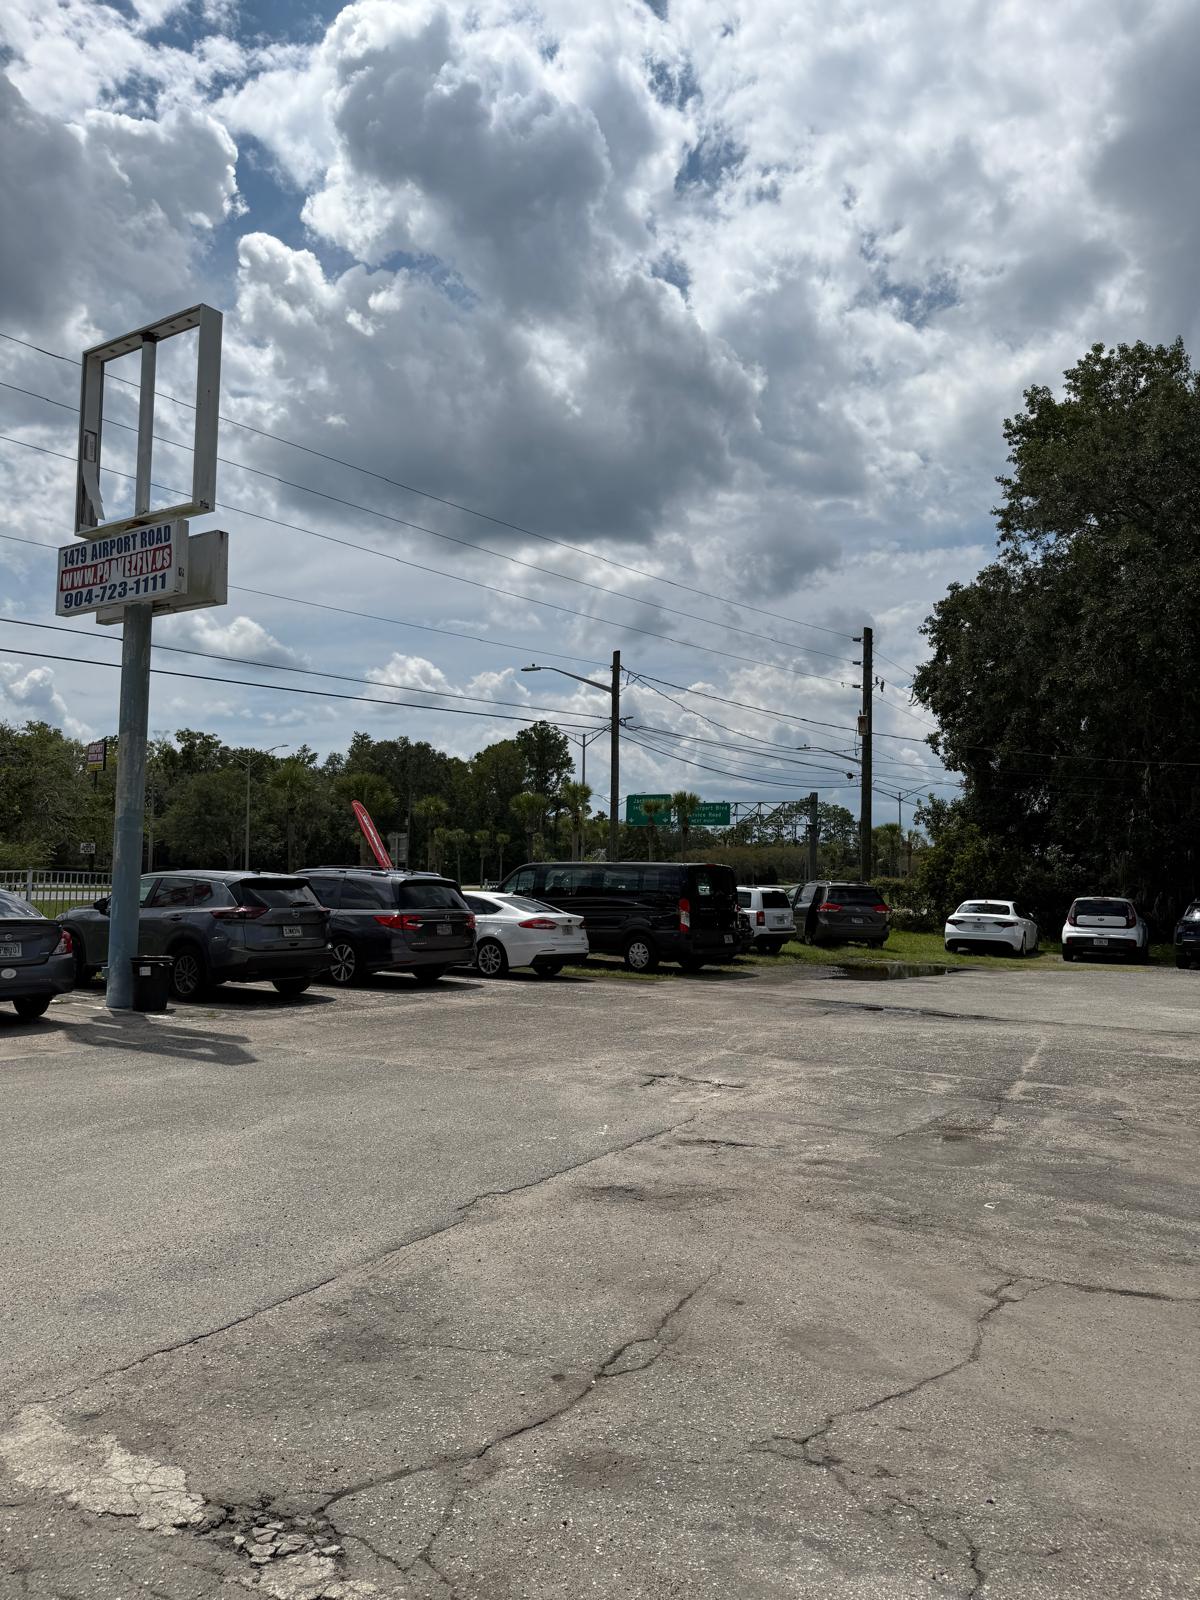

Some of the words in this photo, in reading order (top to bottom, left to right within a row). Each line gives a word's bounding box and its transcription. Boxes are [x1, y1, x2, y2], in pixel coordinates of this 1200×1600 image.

[63, 547, 87, 567] 1479
[91, 533, 138, 562] AIRPORT
[140, 525, 171, 548] ROAD
[64, 572, 167, 609] 904-723-1111
